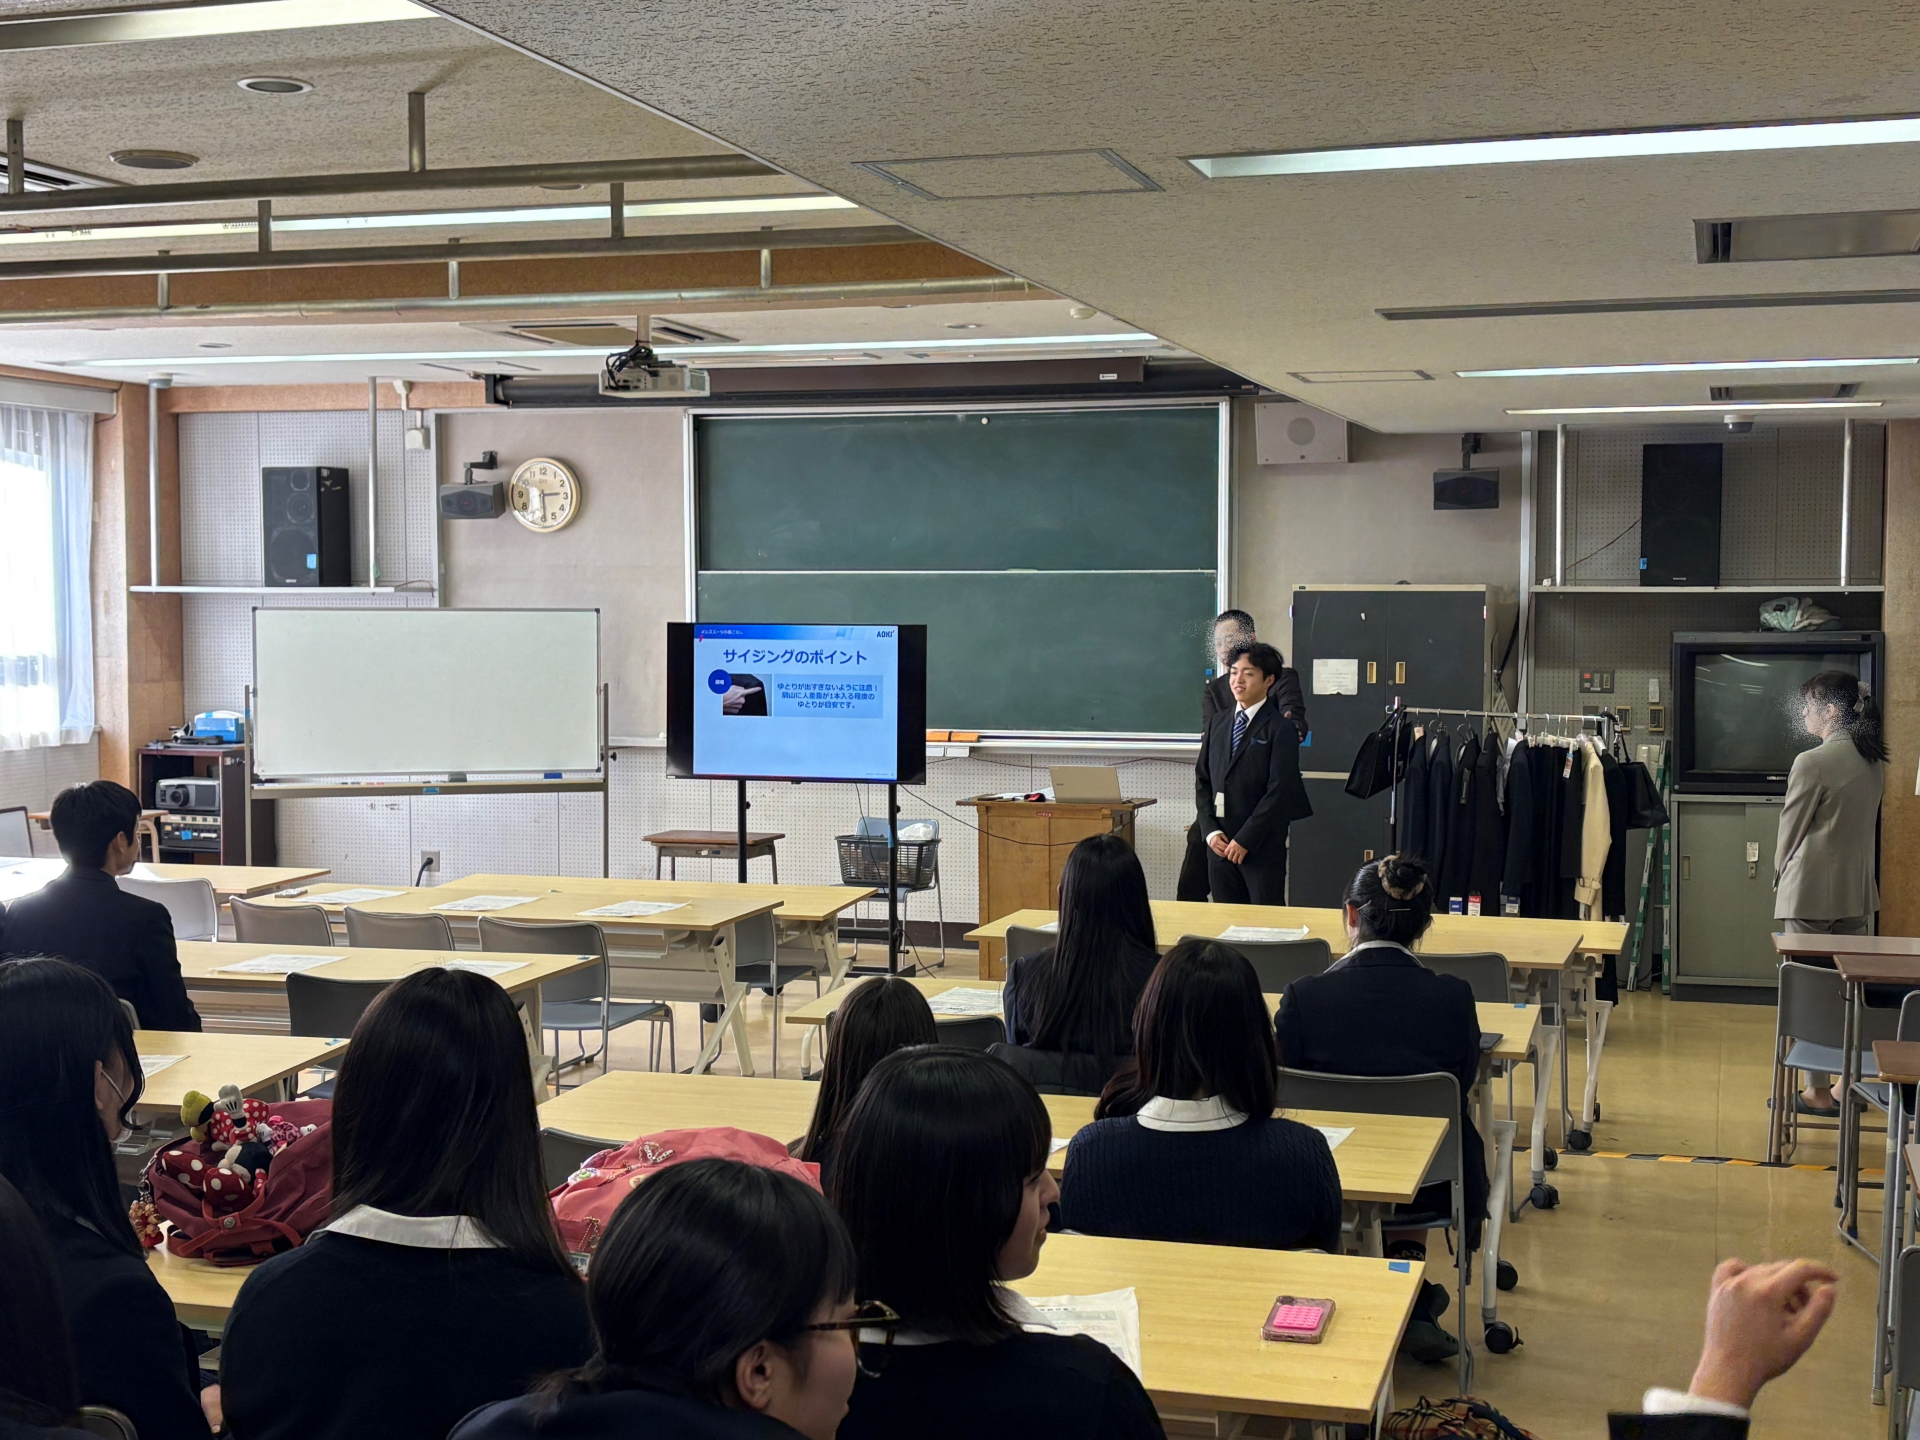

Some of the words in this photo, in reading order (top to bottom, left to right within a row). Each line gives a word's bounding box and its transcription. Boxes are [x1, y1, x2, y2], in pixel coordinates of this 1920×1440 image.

[539, 467, 547, 475] 12
[518, 490, 523, 498] 9
[522, 502, 527, 510] 8
[876, 630, 895, 638] AOKI
[723, 649, 867, 664] サイジングのポイント
[797, 701, 856, 709] ゆとりが目安です。
